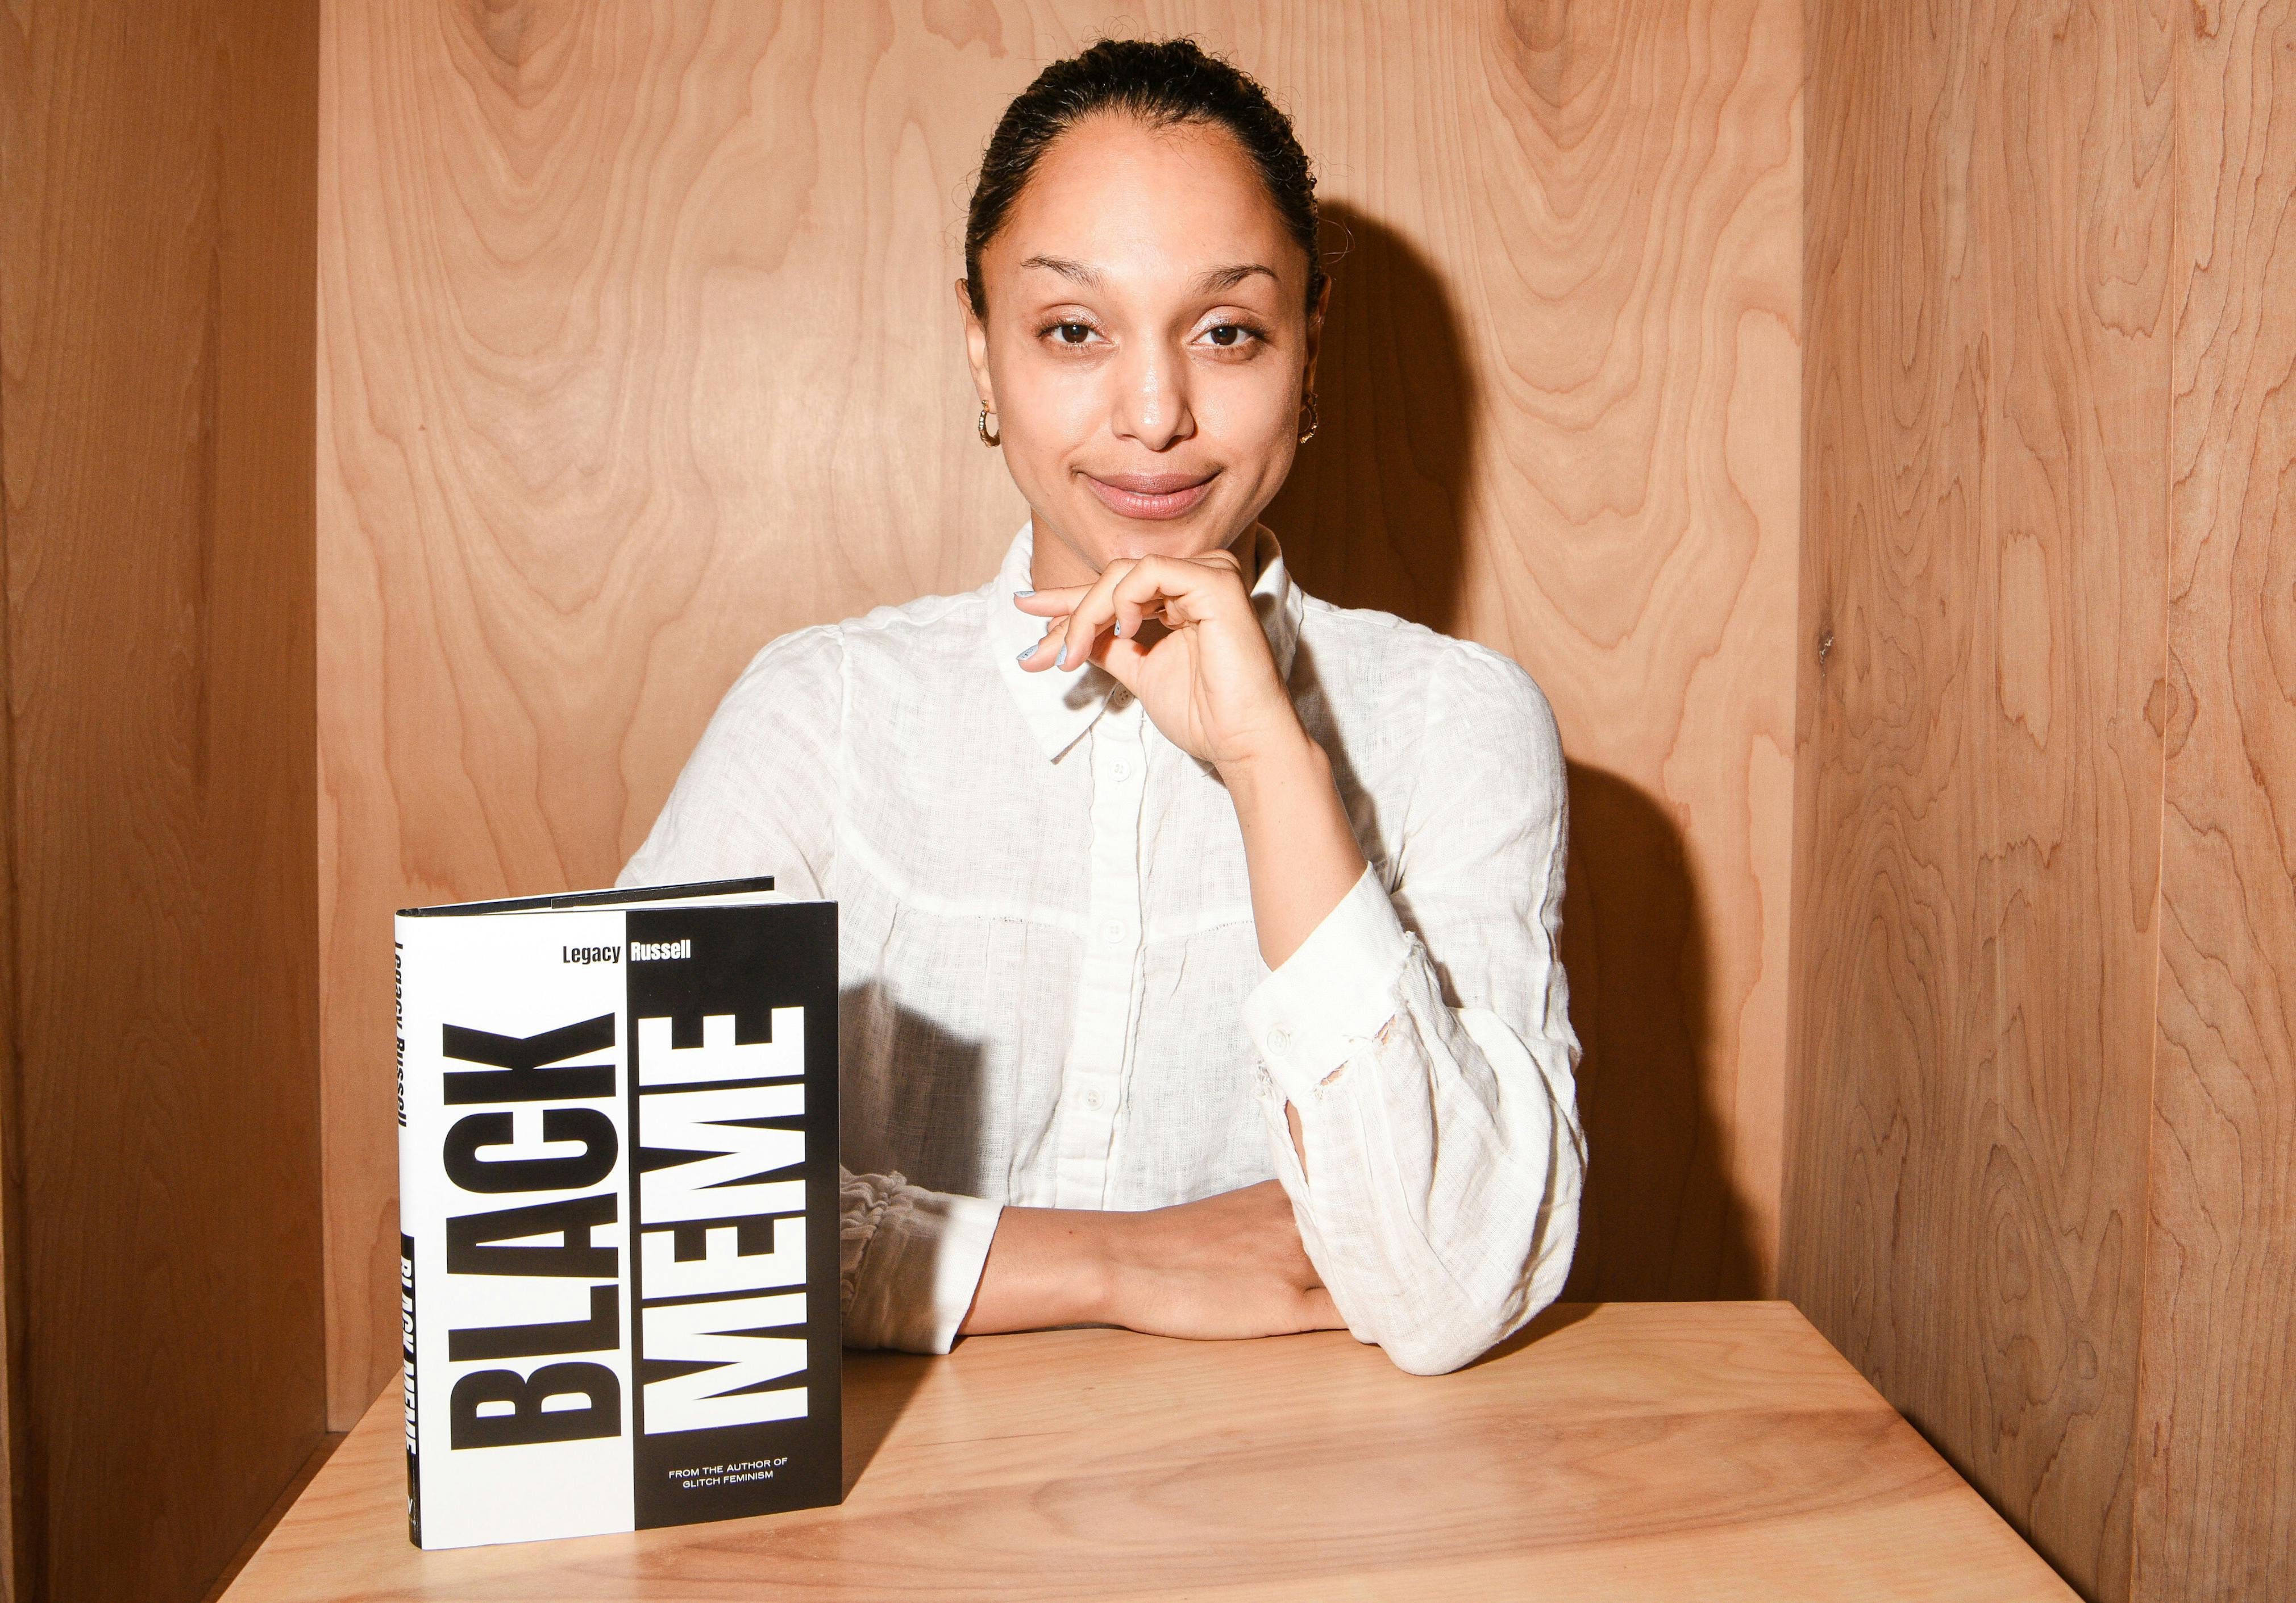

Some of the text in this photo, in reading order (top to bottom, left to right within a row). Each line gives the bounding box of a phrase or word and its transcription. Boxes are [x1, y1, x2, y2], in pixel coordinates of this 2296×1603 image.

[563, 940, 691, 965] Legacy Russell
[443, 1012, 622, 1451] BLACK
[638, 1006, 808, 1435] MEME
[669, 1457, 788, 1479] FROM THE AUTHOR OF
[683, 1471, 773, 1488] GLITCH FEMINISM
